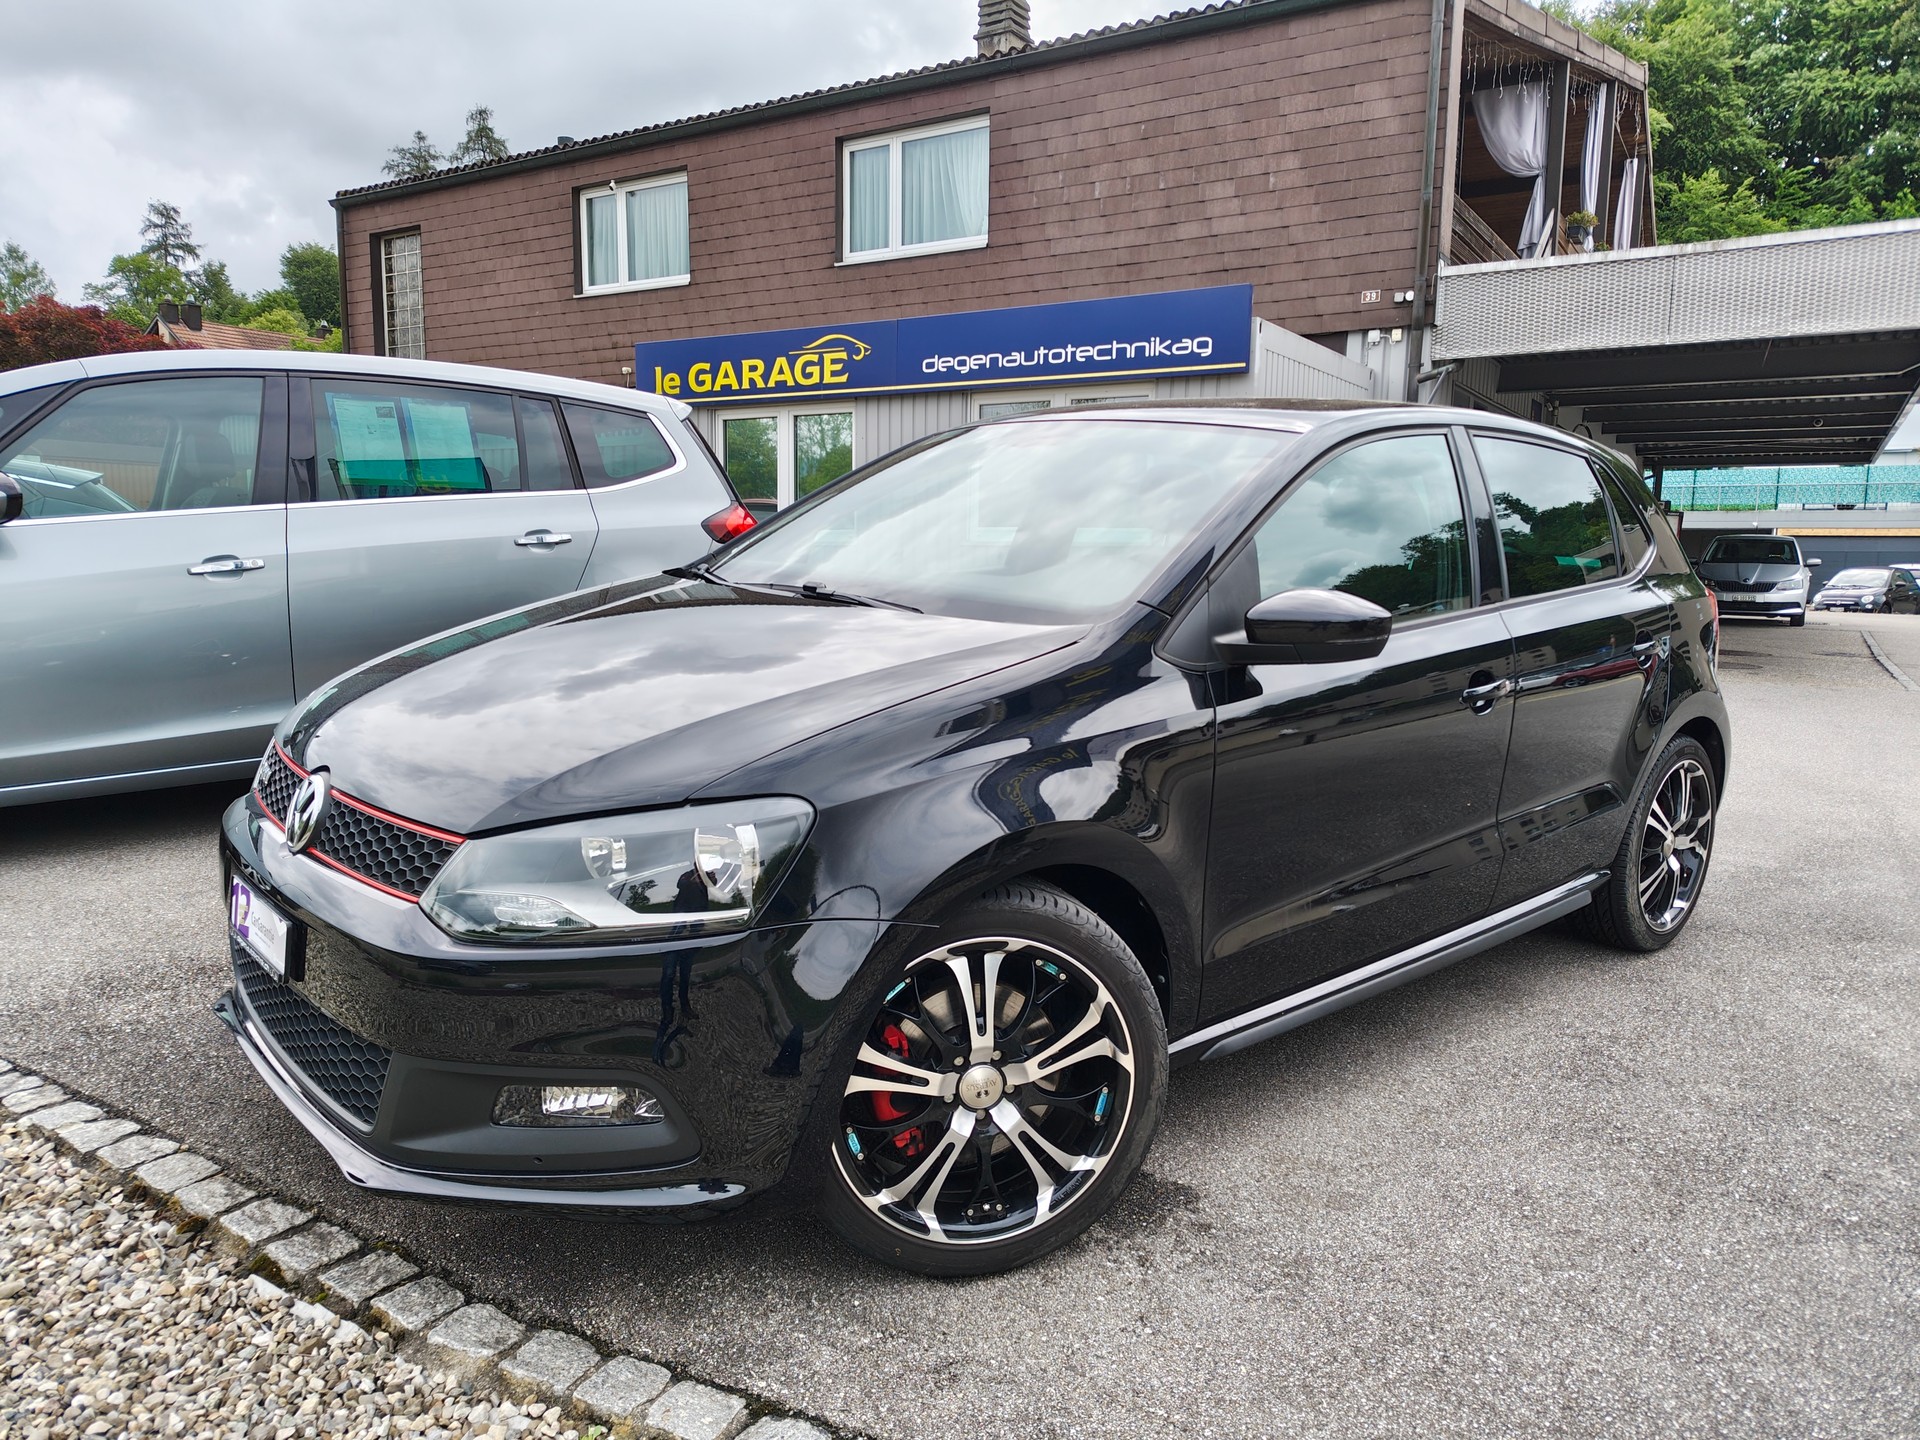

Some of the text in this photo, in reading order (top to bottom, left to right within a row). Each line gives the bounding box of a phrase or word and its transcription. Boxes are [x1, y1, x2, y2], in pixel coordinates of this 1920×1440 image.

[1365, 293, 1377, 301] 39
[654, 351, 849, 395] le GARAGE
